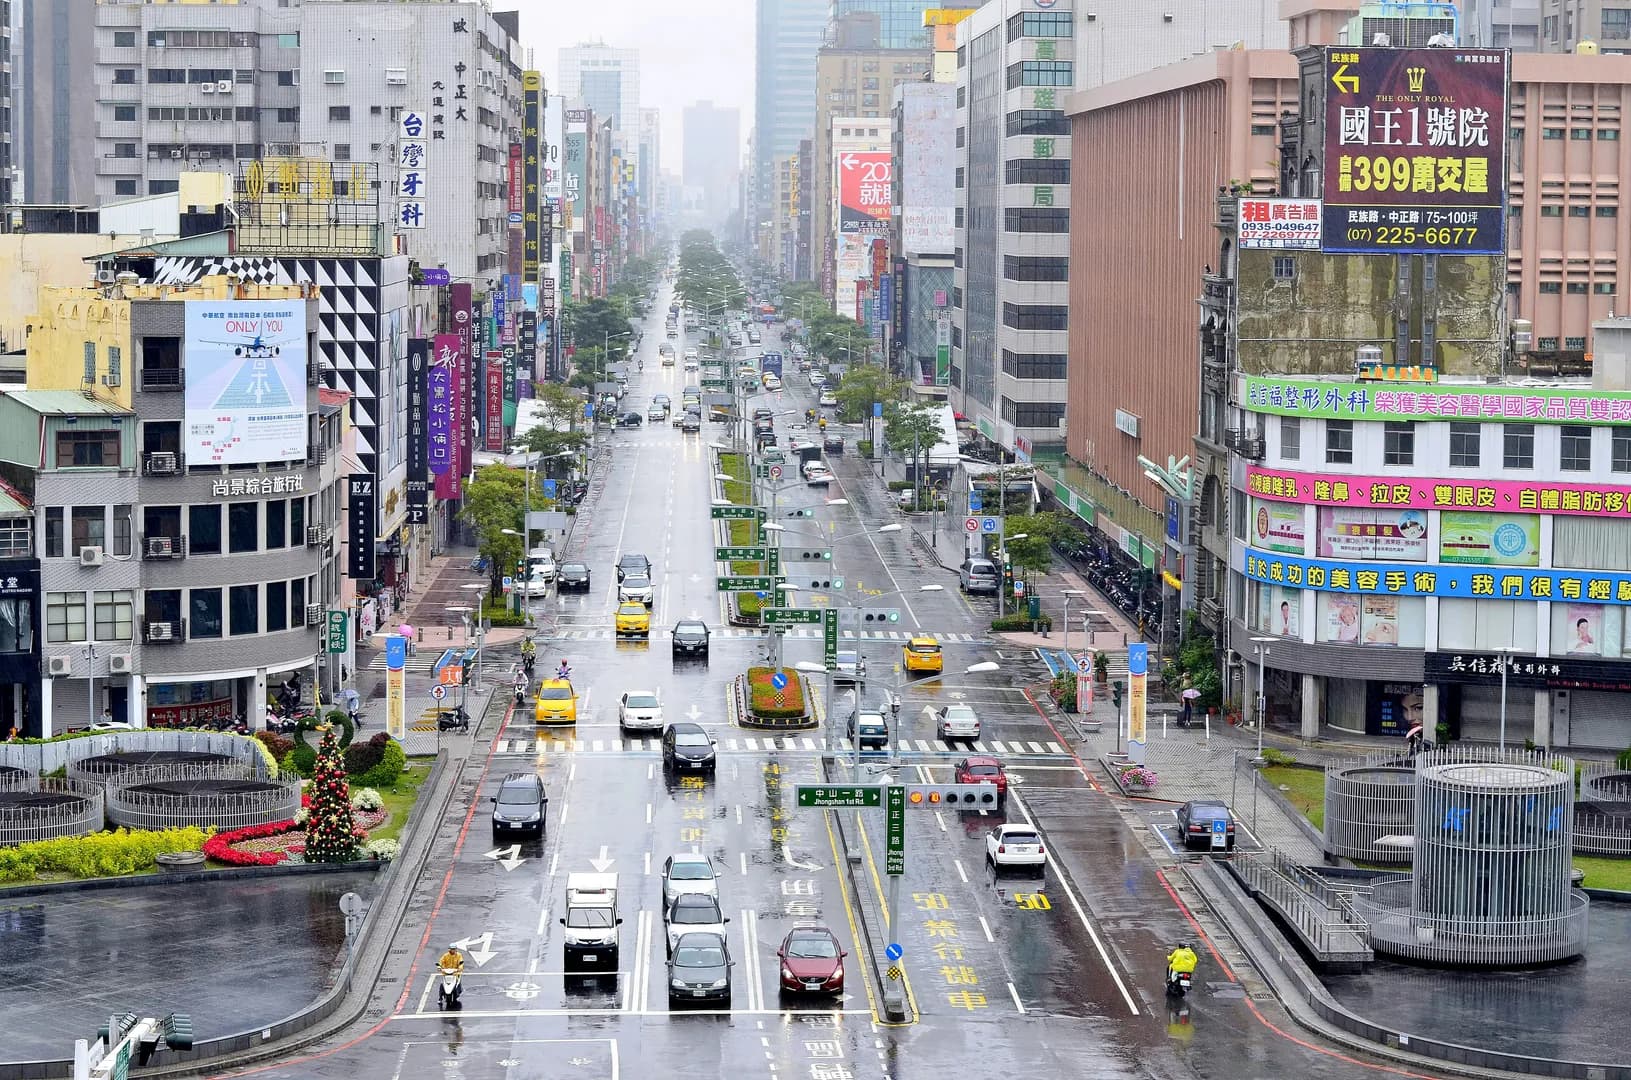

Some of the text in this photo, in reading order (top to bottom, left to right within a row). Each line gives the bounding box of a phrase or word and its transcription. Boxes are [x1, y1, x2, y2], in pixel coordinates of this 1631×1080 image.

[1331, 53, 1360, 63] 民族路
[1425, 95, 1455, 103] ROYAL
[1033, 39, 1057, 207] 高雄郵局
[1339, 105, 1490, 147] 國王1號院
[400, 112, 424, 227] 台灣牙科
[1241, 222, 1320, 231] 0935-049647
[1241, 231, 1320, 239] 07-2269777
[1347, 227, 1478, 244] (07) 225-6677
[226, 320, 283, 333] ONLY YOU
[432, 372, 447, 458] 大黑松小倆口
[213, 474, 303, 496] 尚景綜合旅行社
[352, 482, 372, 493] EZ
[412, 511, 423, 522] P
[815, 788, 864, 797] 中山一路
[814, 798, 846, 806] Jhongshan
[891, 798, 900, 845] 中正三路
[887, 857, 904, 865] Jheng
[912, 893, 949, 910] 50
[1014, 893, 1052, 910] 50
